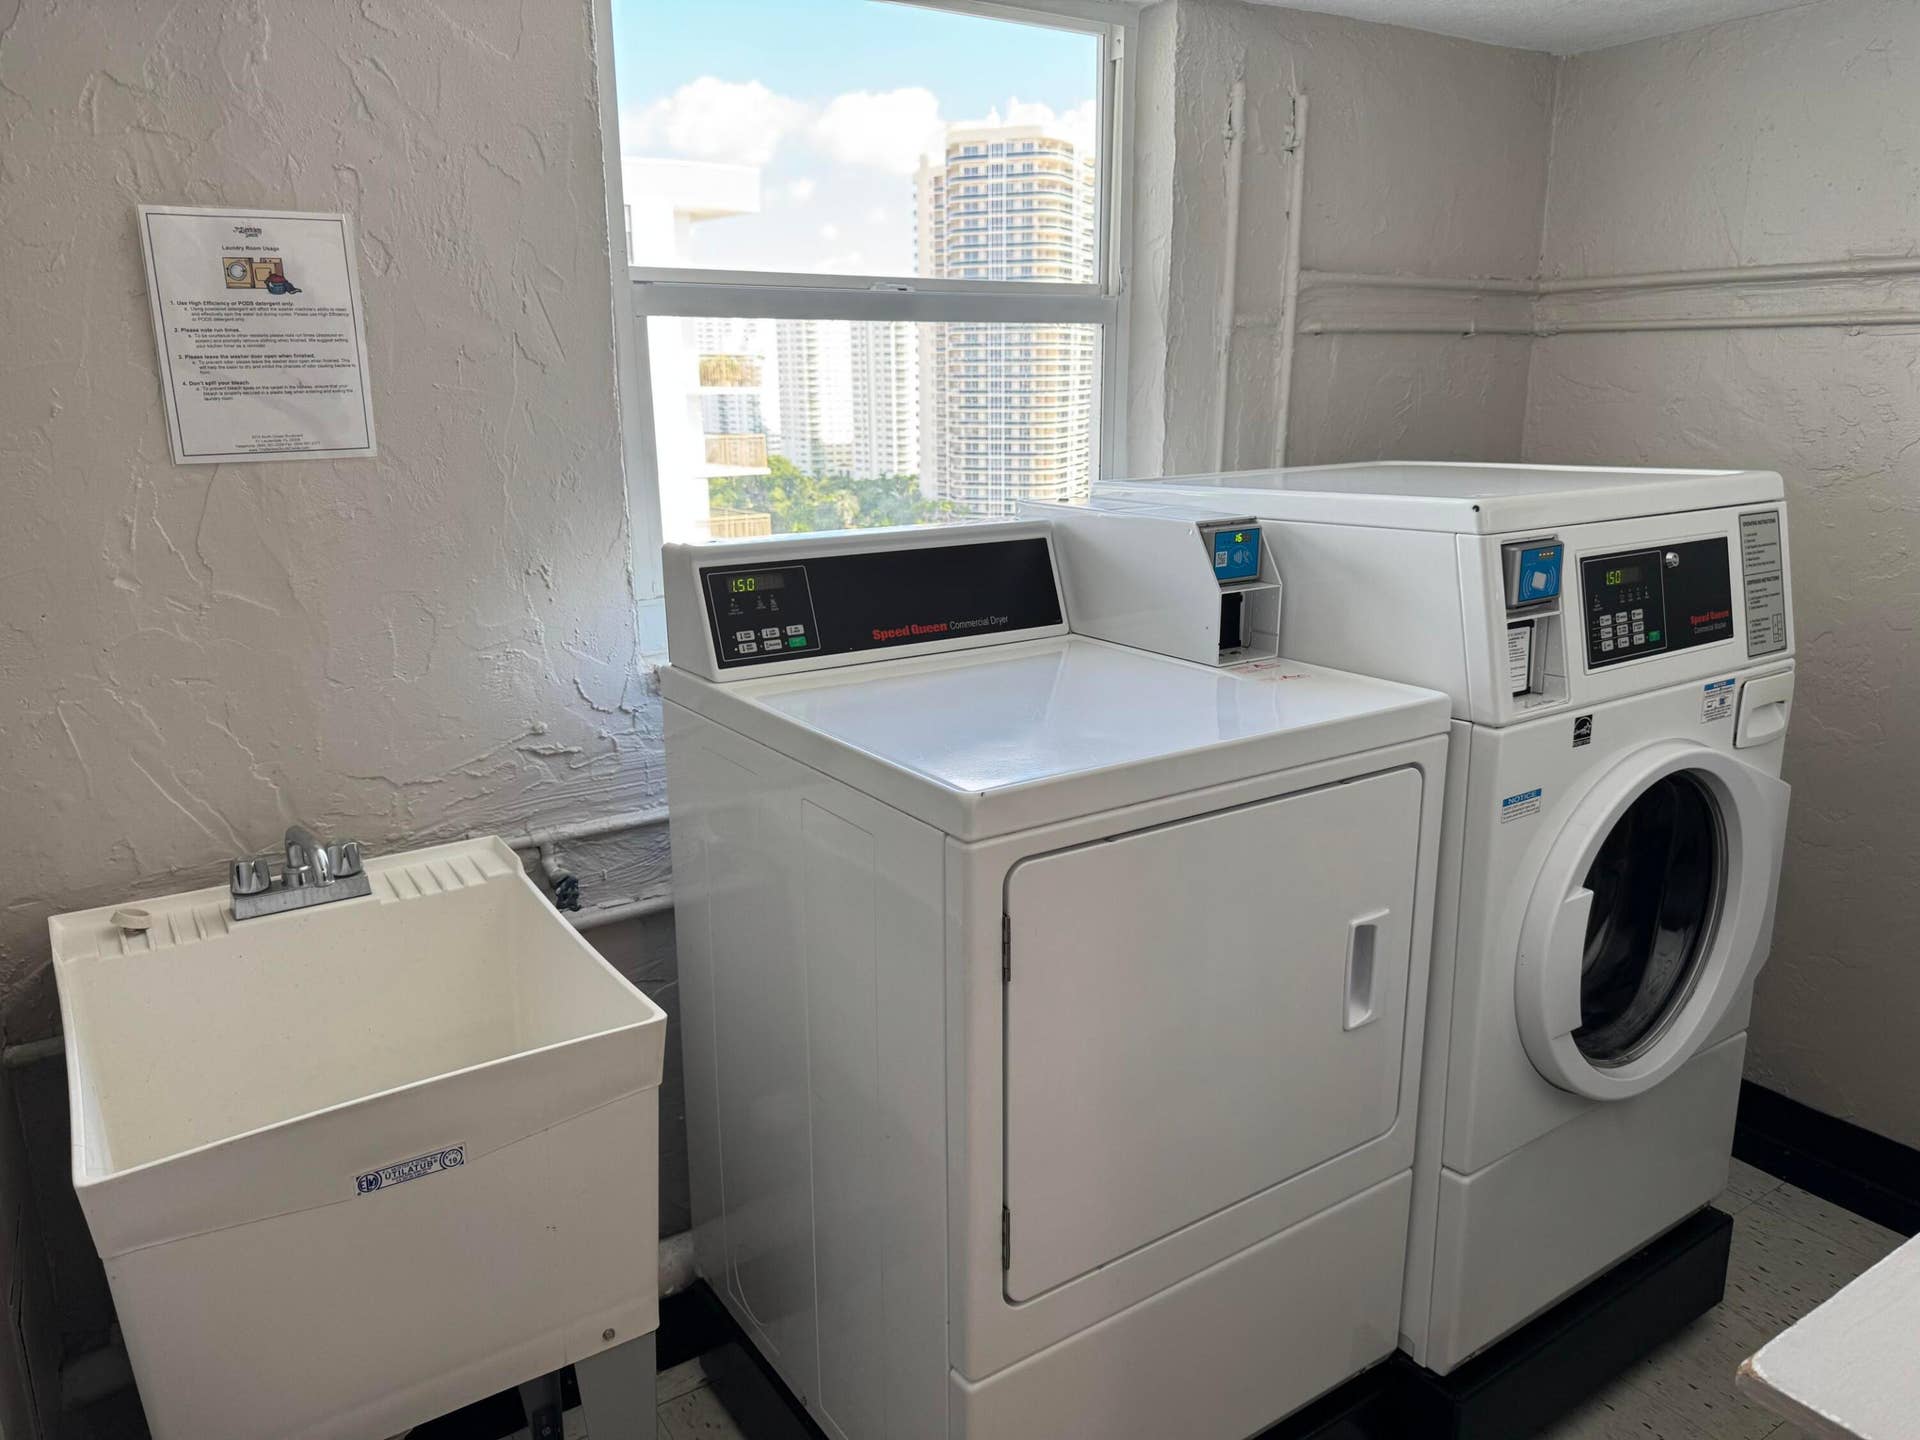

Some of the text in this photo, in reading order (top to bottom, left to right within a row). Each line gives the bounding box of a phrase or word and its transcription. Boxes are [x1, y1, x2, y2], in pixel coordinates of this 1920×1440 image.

[1690, 609, 1729, 625] Speed Queen
[872, 614, 1008, 641] Speed Queen Commercial Dryer
[1507, 791, 1536, 804] NOTICE
